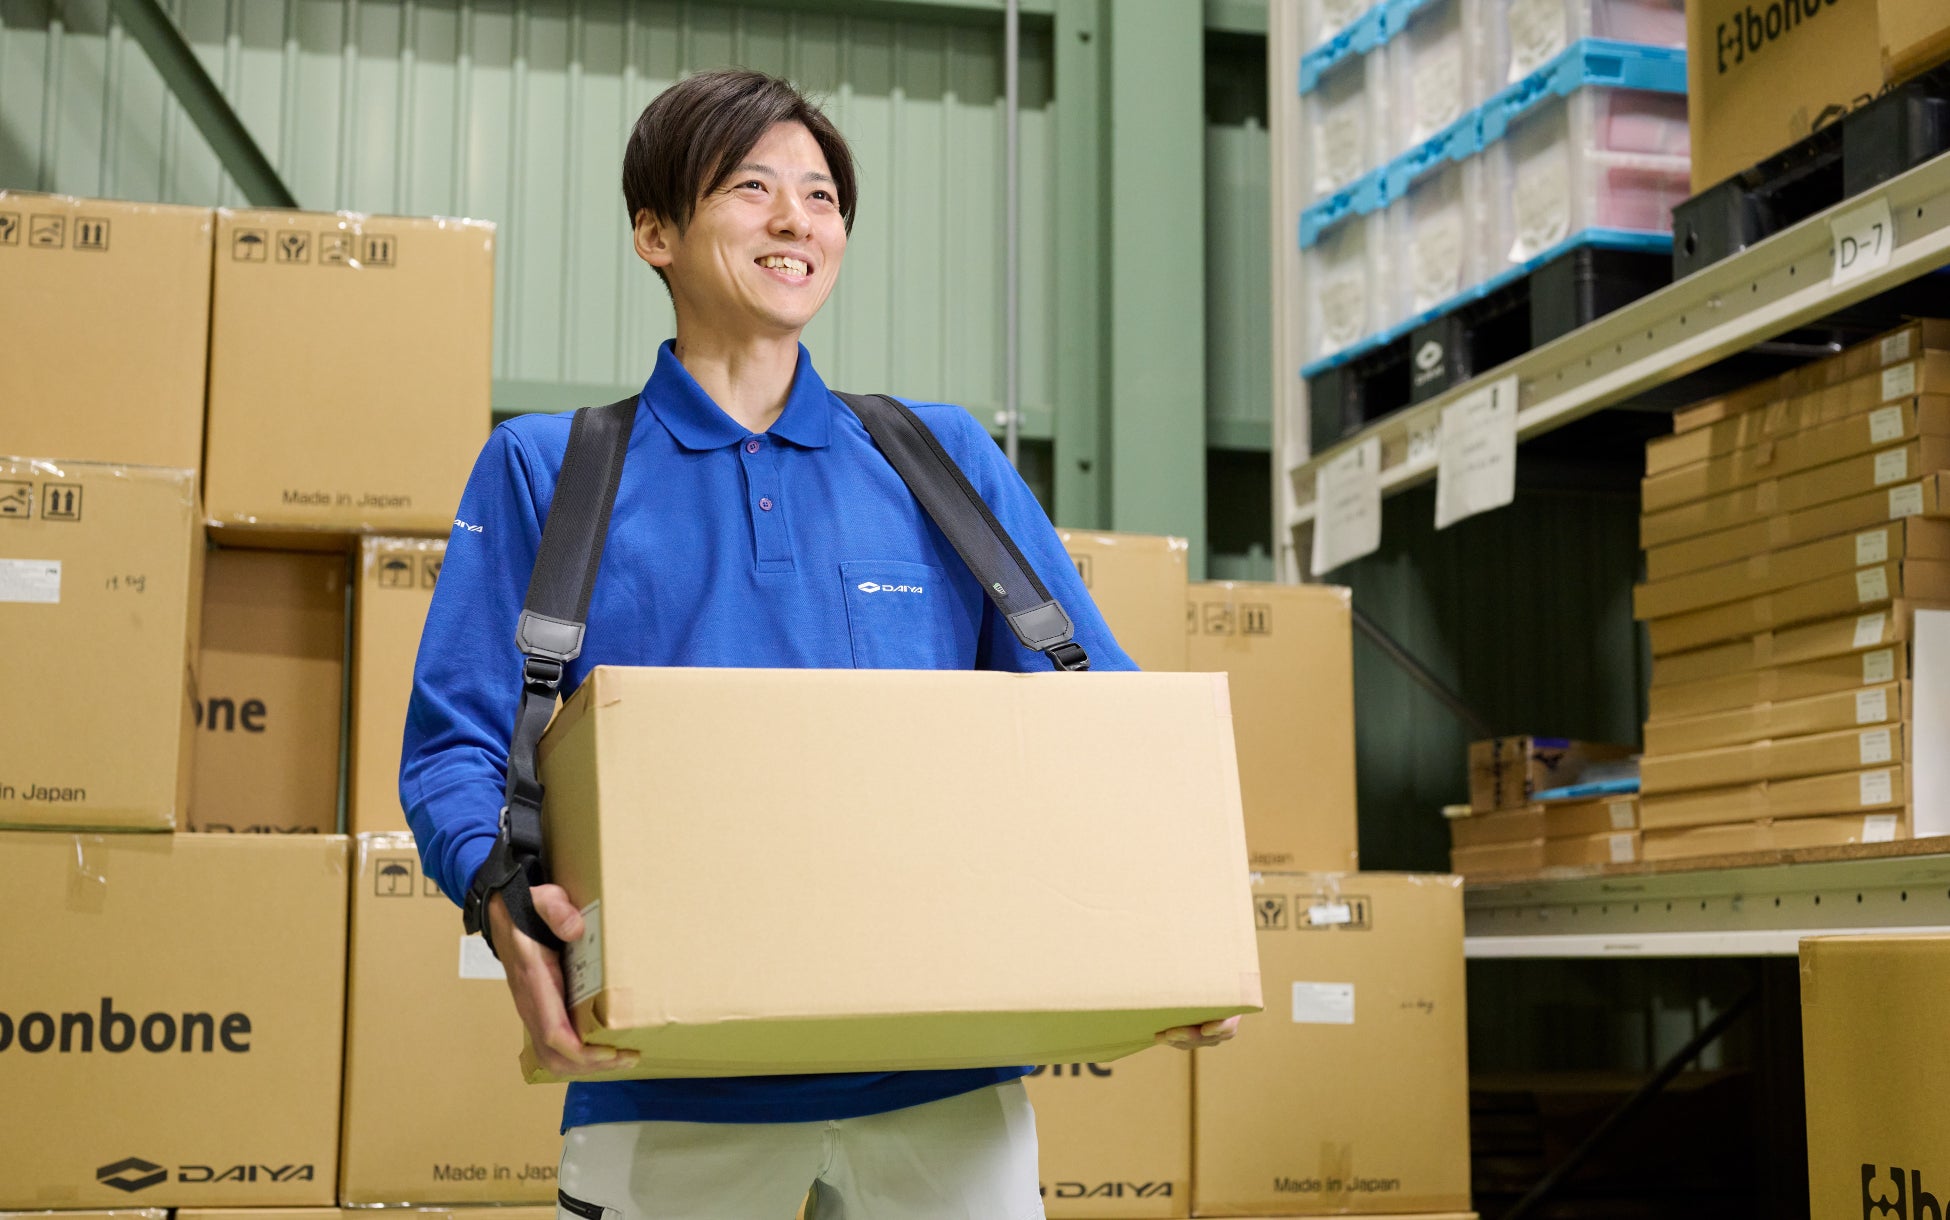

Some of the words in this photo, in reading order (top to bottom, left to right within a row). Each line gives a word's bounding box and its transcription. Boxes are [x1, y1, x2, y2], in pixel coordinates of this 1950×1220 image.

[1841, 222, 1883, 269] D-7
[282, 489, 330, 506] Made
[356, 491, 411, 509] Japan
[882, 584, 923, 594] DAIYA
[196, 697, 267, 732] ne
[22, 783, 86, 803] Japan
[178, 1165, 314, 1182] DAIYA
[433, 1164, 487, 1181] Made
[493, 1164, 511, 1180] in
[1056, 1182, 1173, 1198] DAIYA
[1273, 1177, 1321, 1193] Made
[1346, 1176, 1400, 1195] Japan
